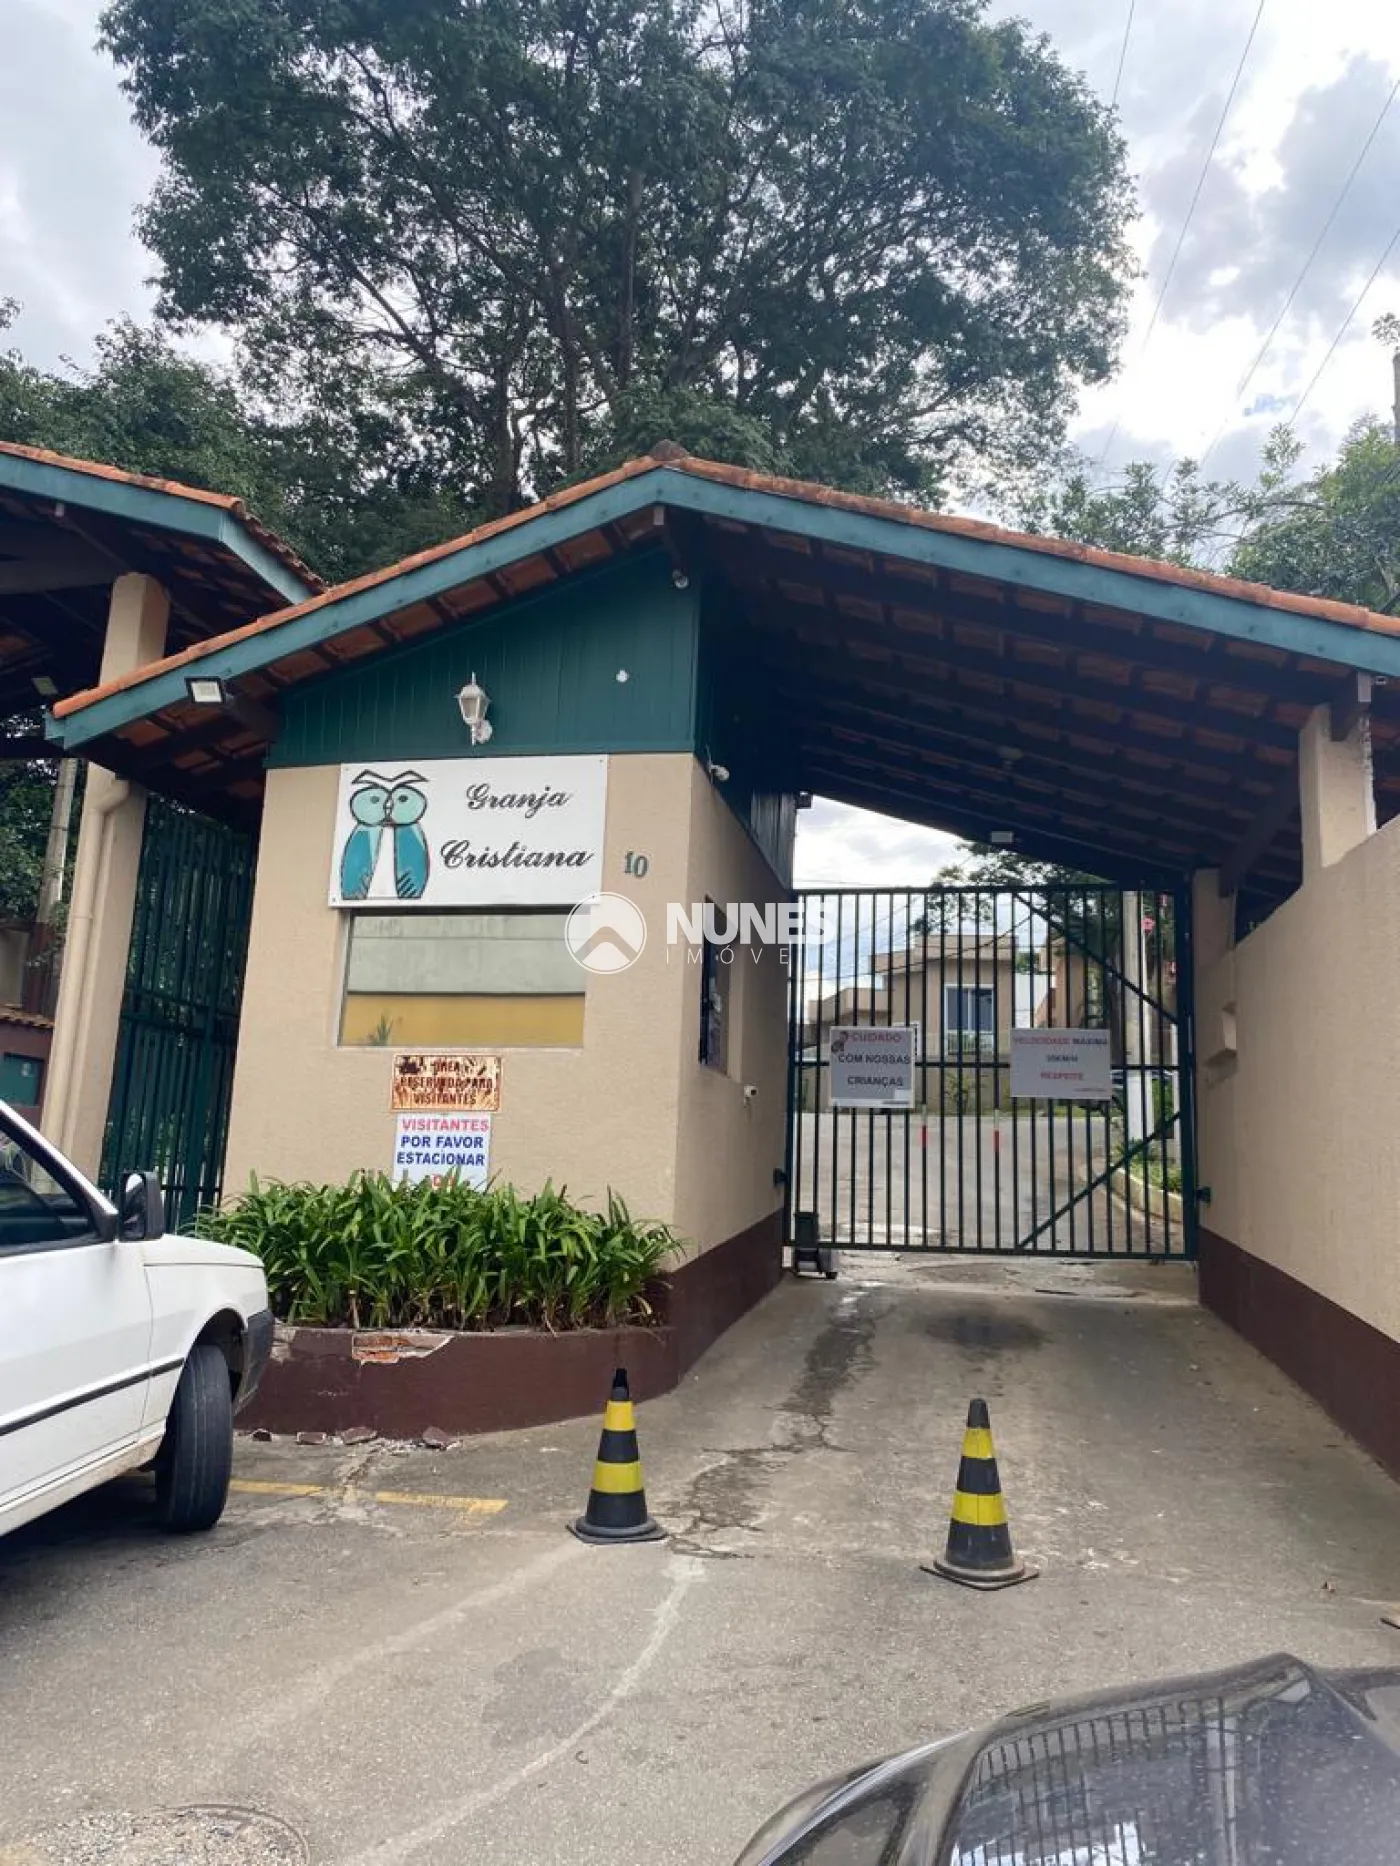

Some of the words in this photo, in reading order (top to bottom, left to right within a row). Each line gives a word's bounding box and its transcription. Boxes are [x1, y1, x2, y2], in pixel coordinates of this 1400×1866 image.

[466, 783, 572, 818] Granja
[440, 840, 594, 868] Cristiana
[624, 850, 648, 878] 10
[838, 1054, 863, 1063] COM
[866, 1054, 911, 1065] NOSSAS
[847, 1076, 904, 1088] CRIANÇAS
[402, 1118, 489, 1131] VISITANTES
[400, 1135, 431, 1148] POR
[436, 1135, 484, 1149] FAVOR
[396, 1151, 485, 1166] ESTACIONAR
